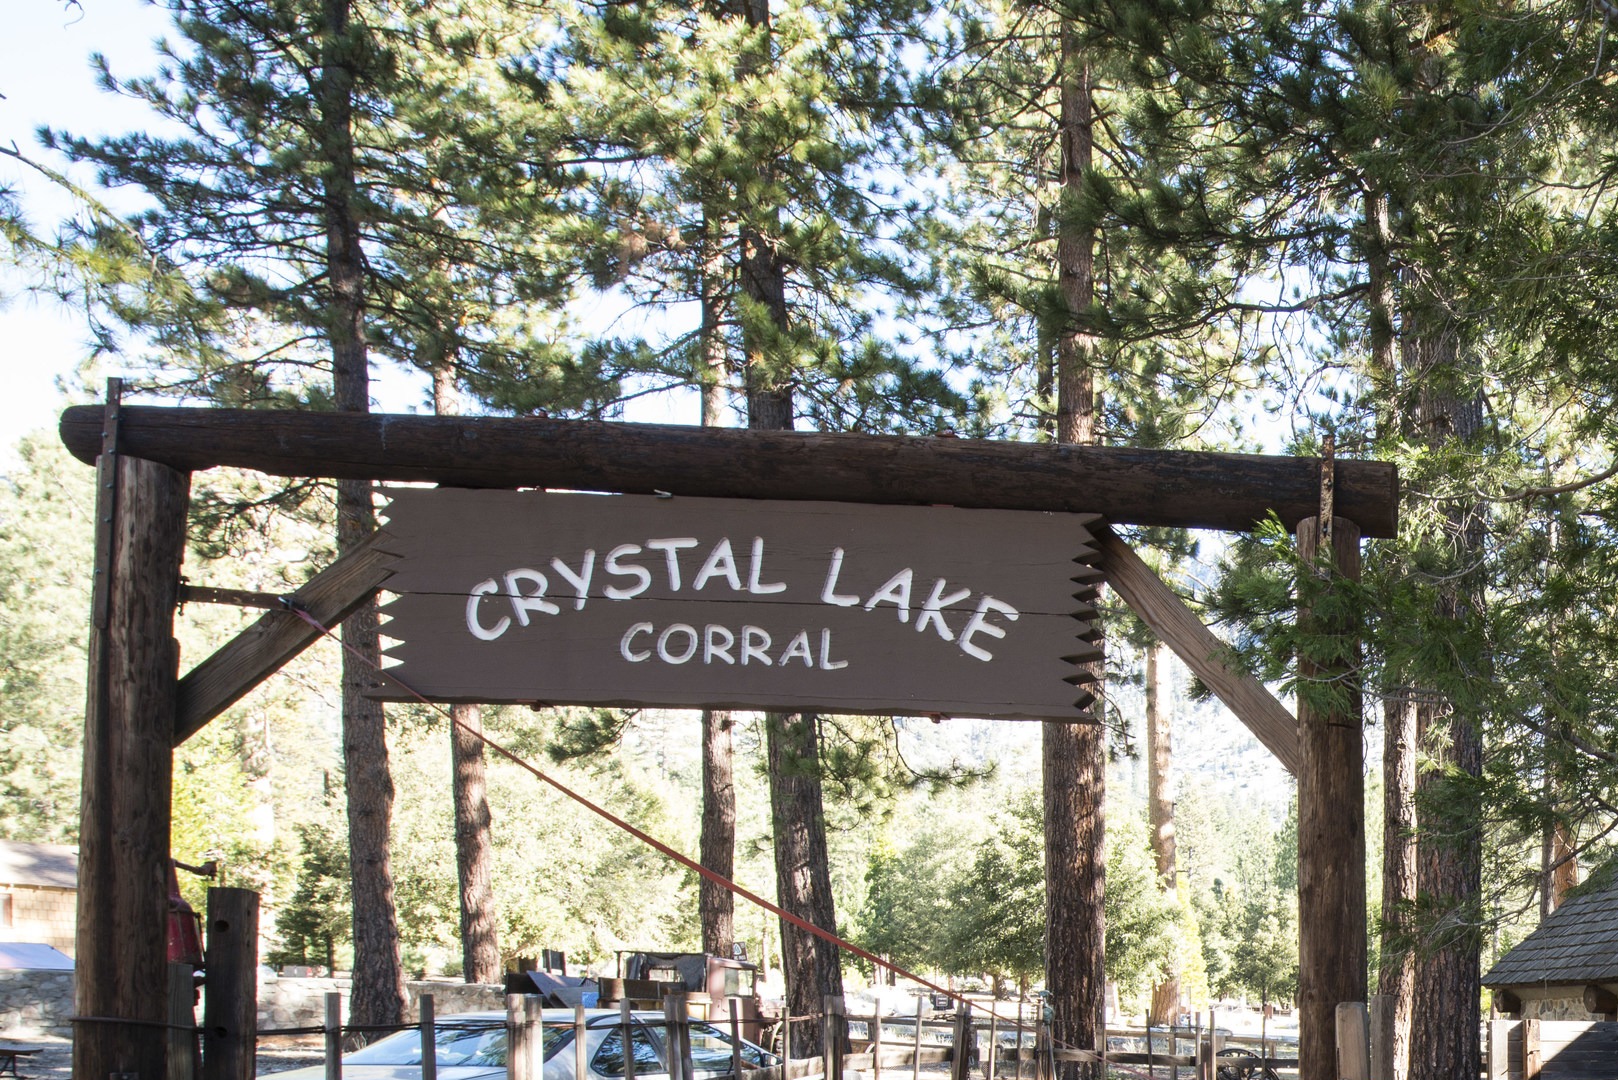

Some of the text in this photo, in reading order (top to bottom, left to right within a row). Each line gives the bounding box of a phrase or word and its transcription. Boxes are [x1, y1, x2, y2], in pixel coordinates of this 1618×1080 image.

[464, 536, 1021, 662] CRYSTAL LAKE
[620, 621, 849, 671] CORRAL
